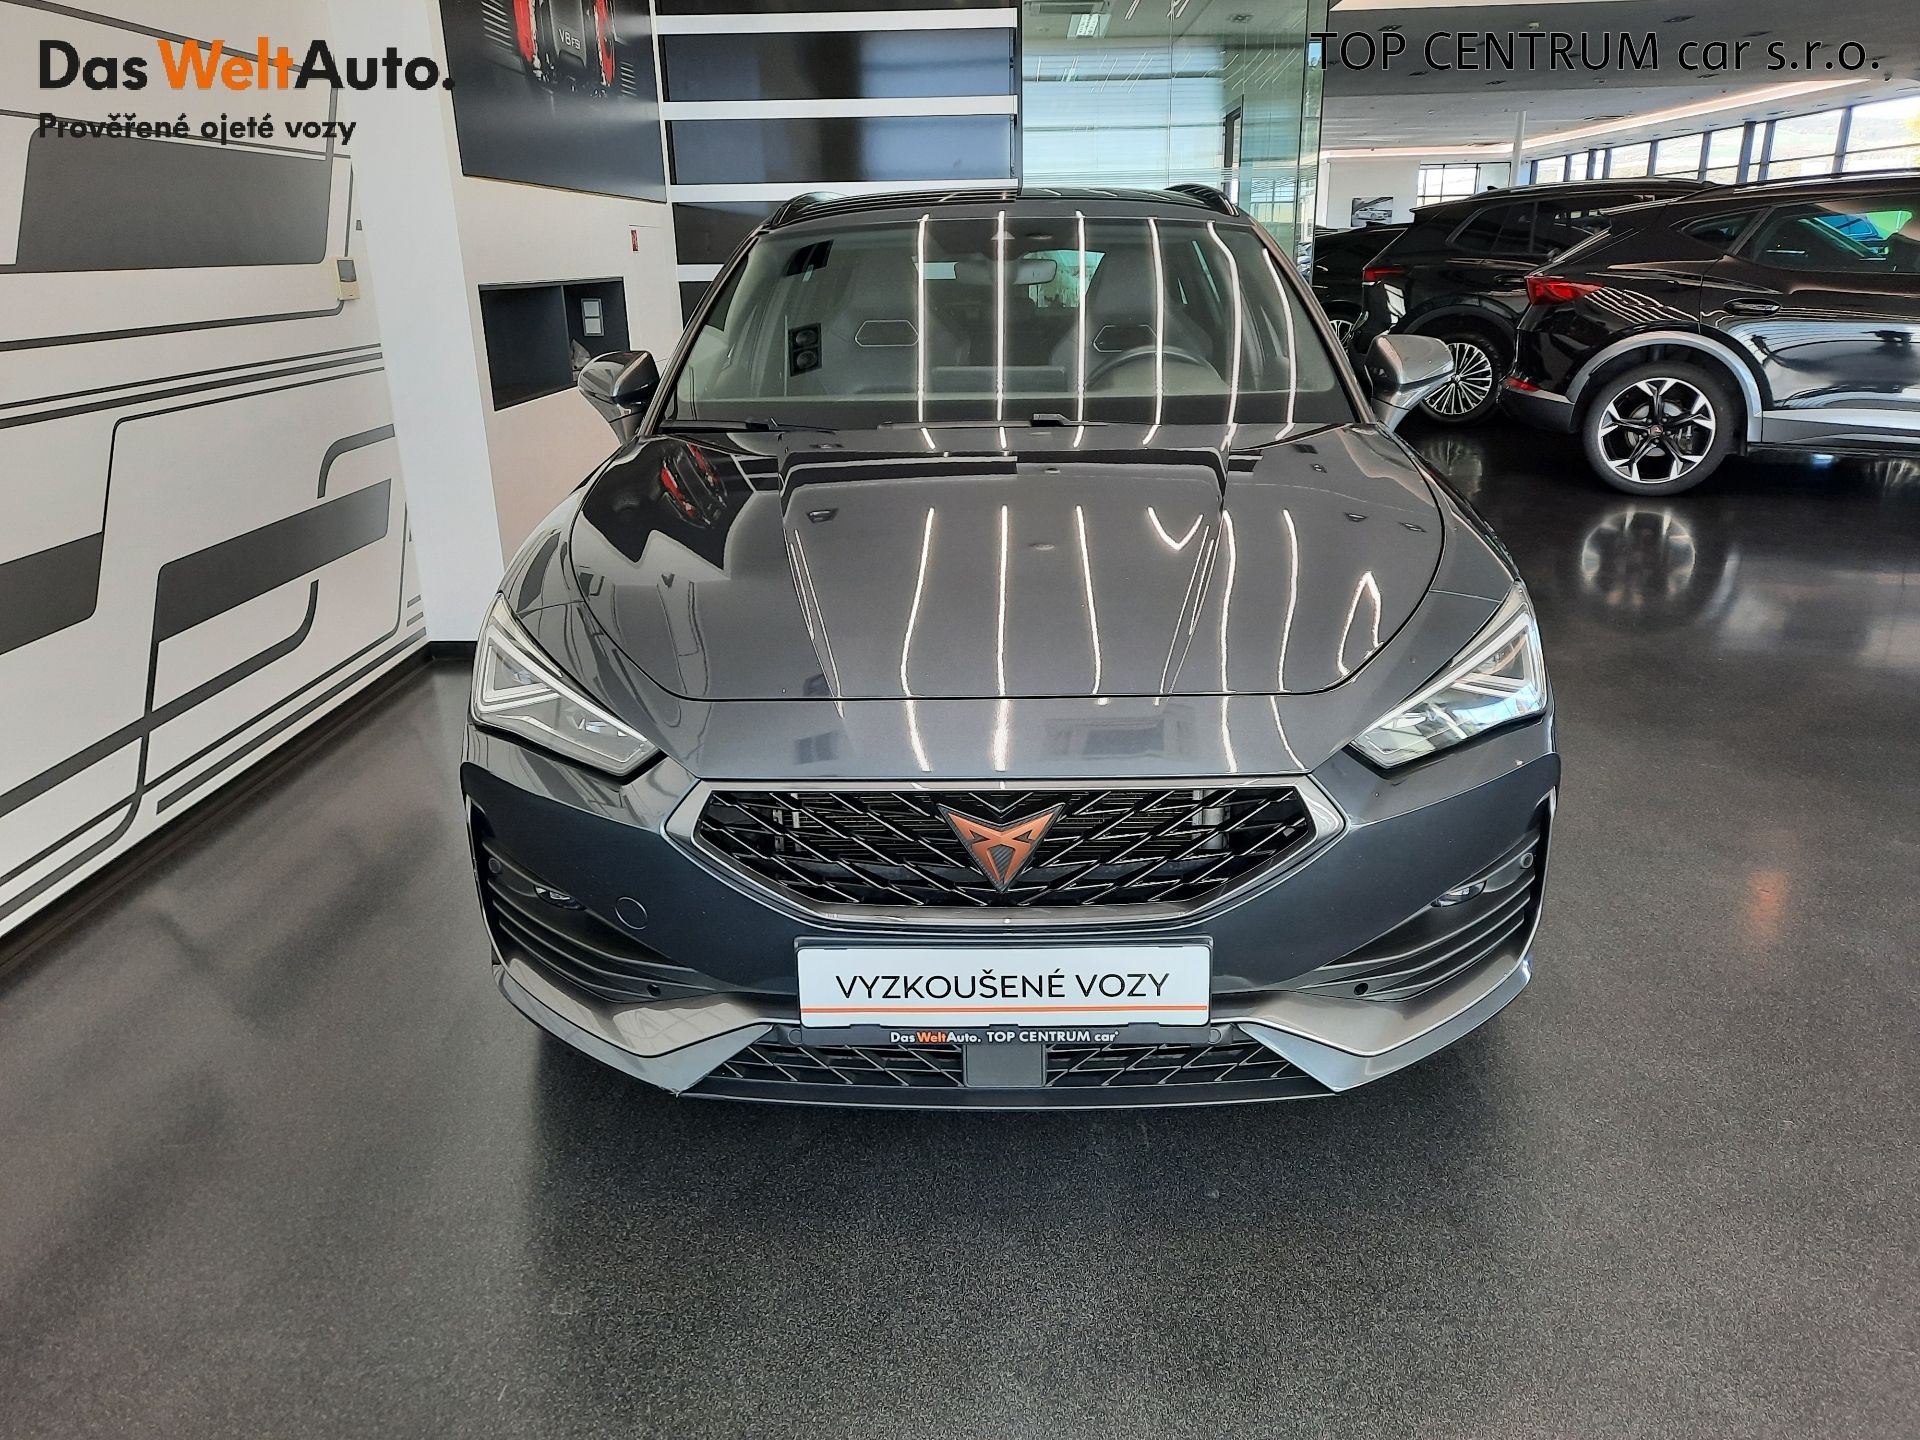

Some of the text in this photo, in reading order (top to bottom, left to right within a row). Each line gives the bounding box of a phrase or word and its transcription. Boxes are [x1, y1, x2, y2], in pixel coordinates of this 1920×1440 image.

[836, 968, 1170, 999] VYZKOUŠENÉ VOZY
[890, 1032, 915, 1043] Das
[917, 1031, 981, 1043] WeltAuto.
[987, 1031, 1015, 1042] TOP
[1019, 1031, 1091, 1042] CENTRUM
